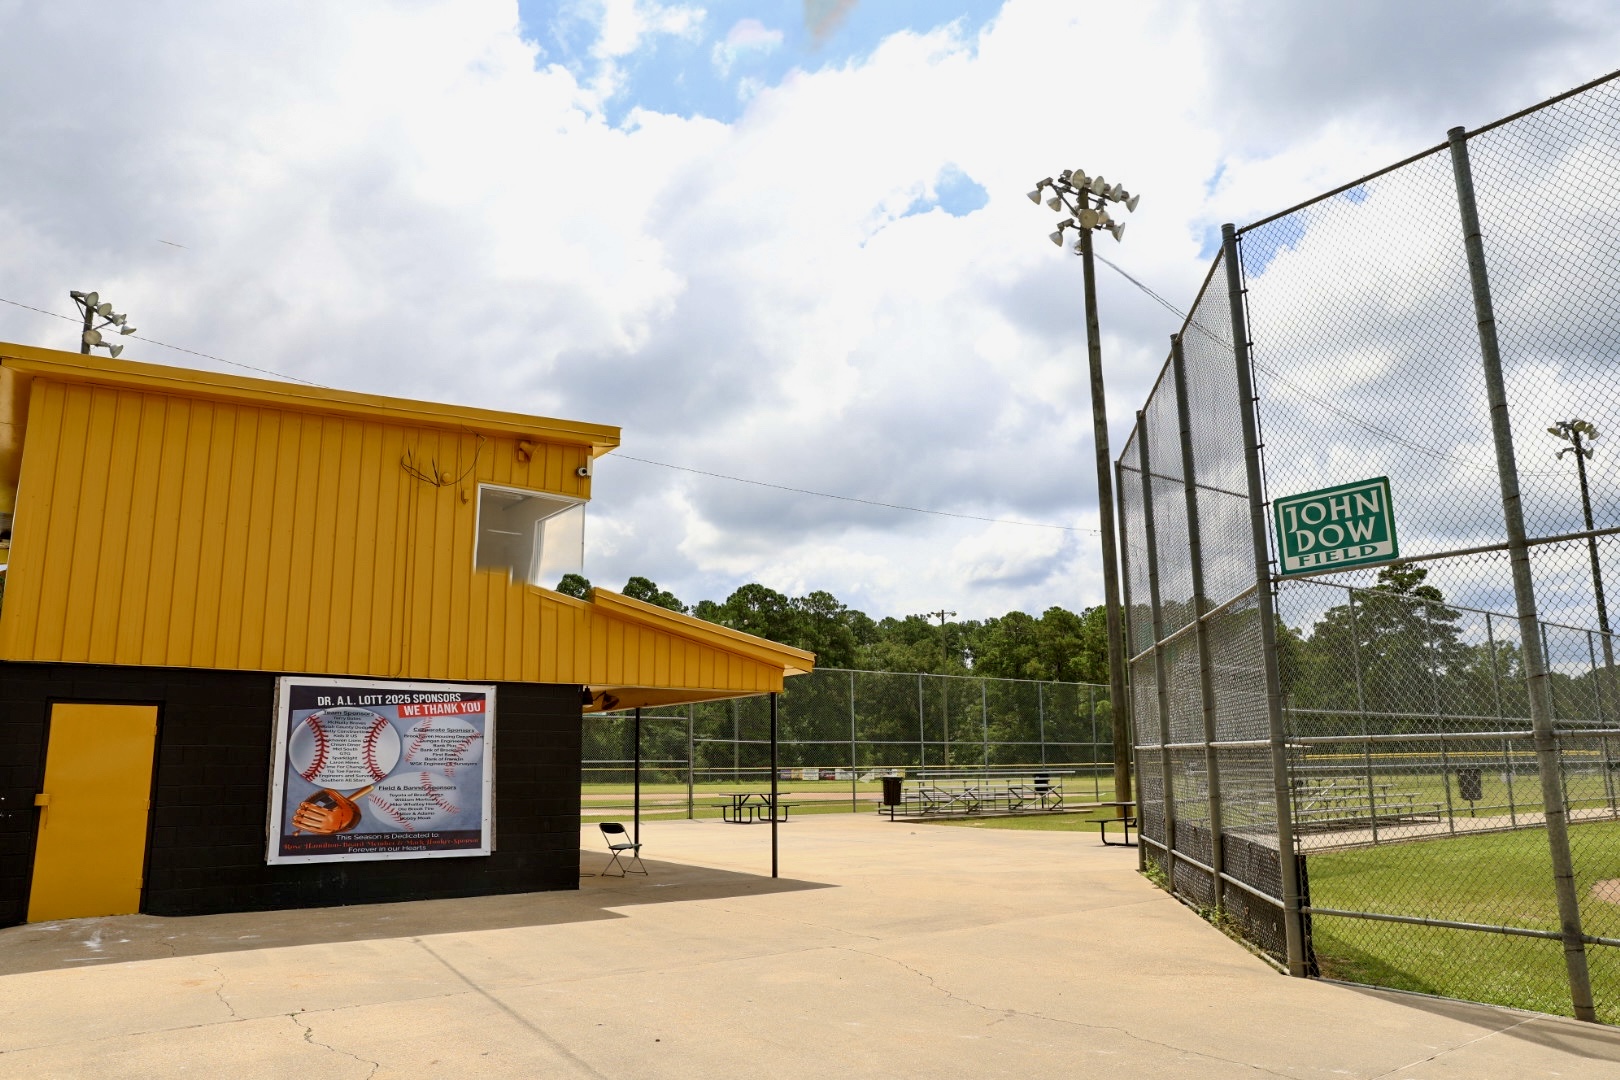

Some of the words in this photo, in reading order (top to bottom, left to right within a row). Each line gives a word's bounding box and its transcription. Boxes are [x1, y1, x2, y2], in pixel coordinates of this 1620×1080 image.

[1285, 489, 1380, 534] JOHN
[1295, 516, 1376, 553] DOW
[1298, 544, 1378, 567] FIELD
[317, 696, 335, 706] DR.
[337, 696, 356, 706] A.L.
[358, 695, 383, 705] LOTT
[385, 694, 411, 704] 2025
[413, 693, 461, 703] SPONSORS
[404, 705, 426, 716] WE
[427, 703, 459, 715] THANK
[461, 702, 481, 713] YOU
